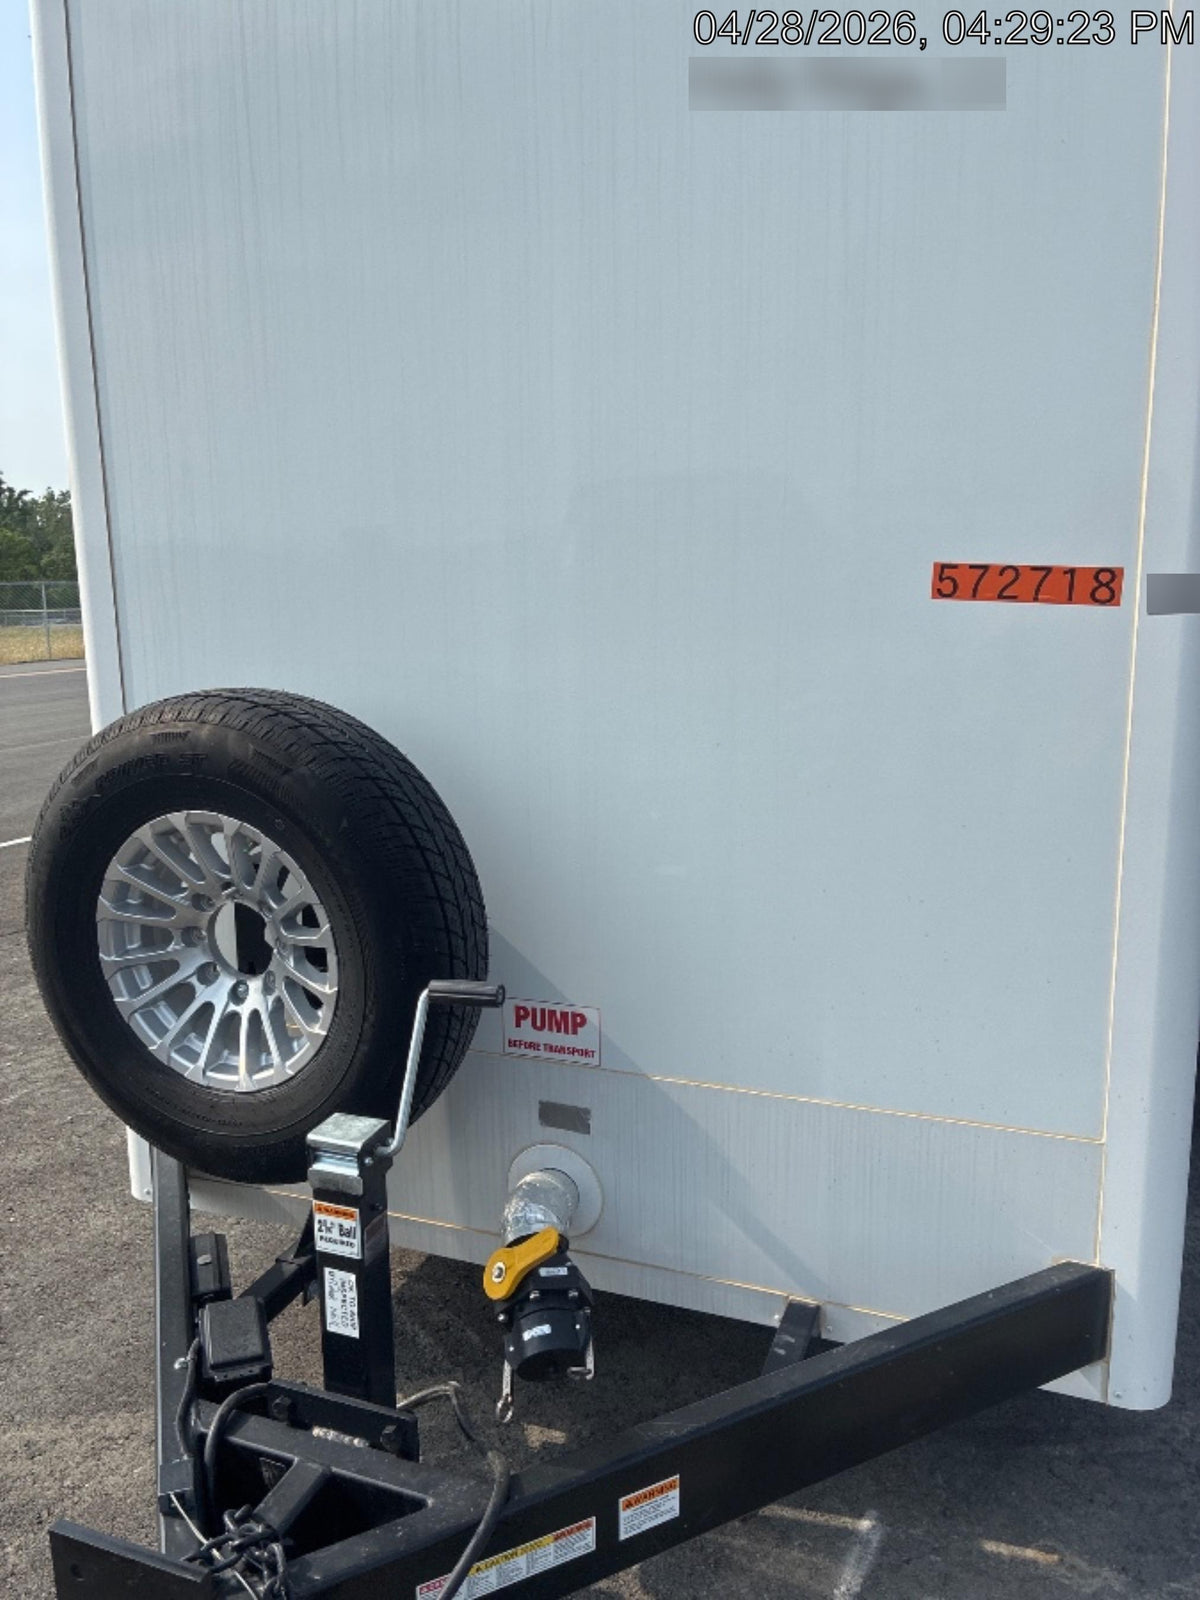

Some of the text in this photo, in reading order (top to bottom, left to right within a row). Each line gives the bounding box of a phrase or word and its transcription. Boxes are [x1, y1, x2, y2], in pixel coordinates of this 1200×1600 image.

[936, 563, 1117, 605] 572718
[514, 1004, 587, 1036] PUMP
[508, 1038, 596, 1059] BEFORE TRANSPORT
[338, 1223, 356, 1240] Ball
